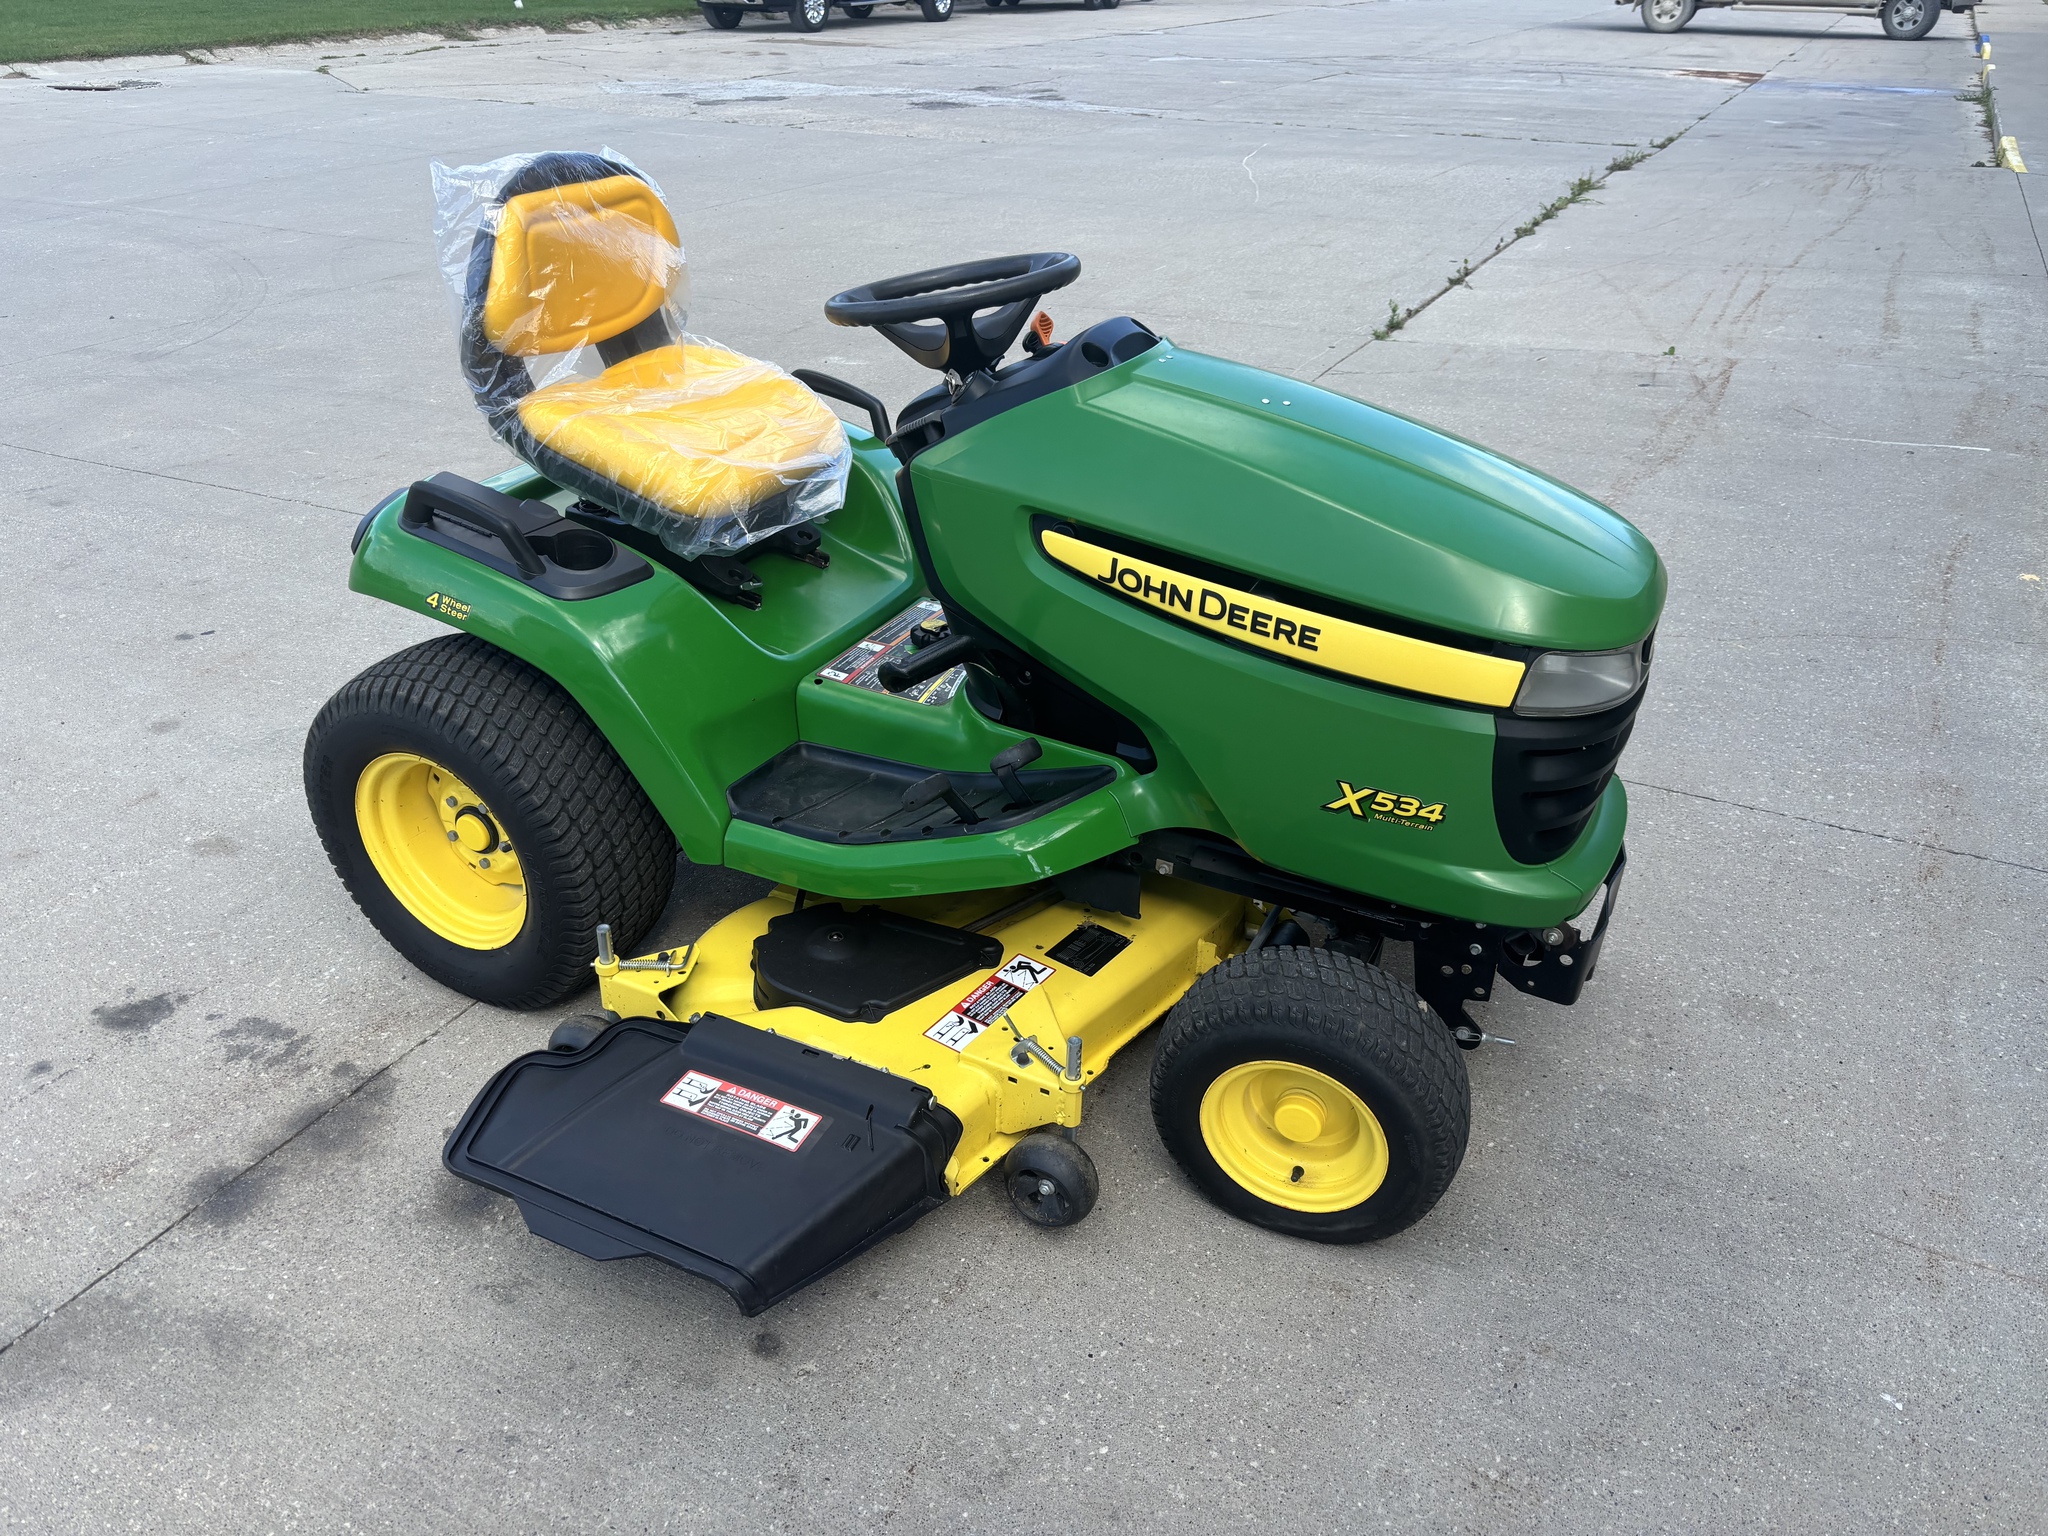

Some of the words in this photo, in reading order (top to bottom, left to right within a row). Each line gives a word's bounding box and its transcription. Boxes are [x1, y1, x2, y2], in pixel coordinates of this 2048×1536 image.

[426, 592, 440, 608] 4
[442, 594, 471, 613] Wheel
[440, 603, 468, 621] Steer
[1097, 557, 1193, 613] JOHN
[1198, 587, 1321, 652] DEERE
[1322, 780, 1445, 823] X534
[1373, 813, 1434, 831] Multi-Terrain
[967, 980, 994, 1003] DANGER
[737, 1088, 779, 1108] DANGER
